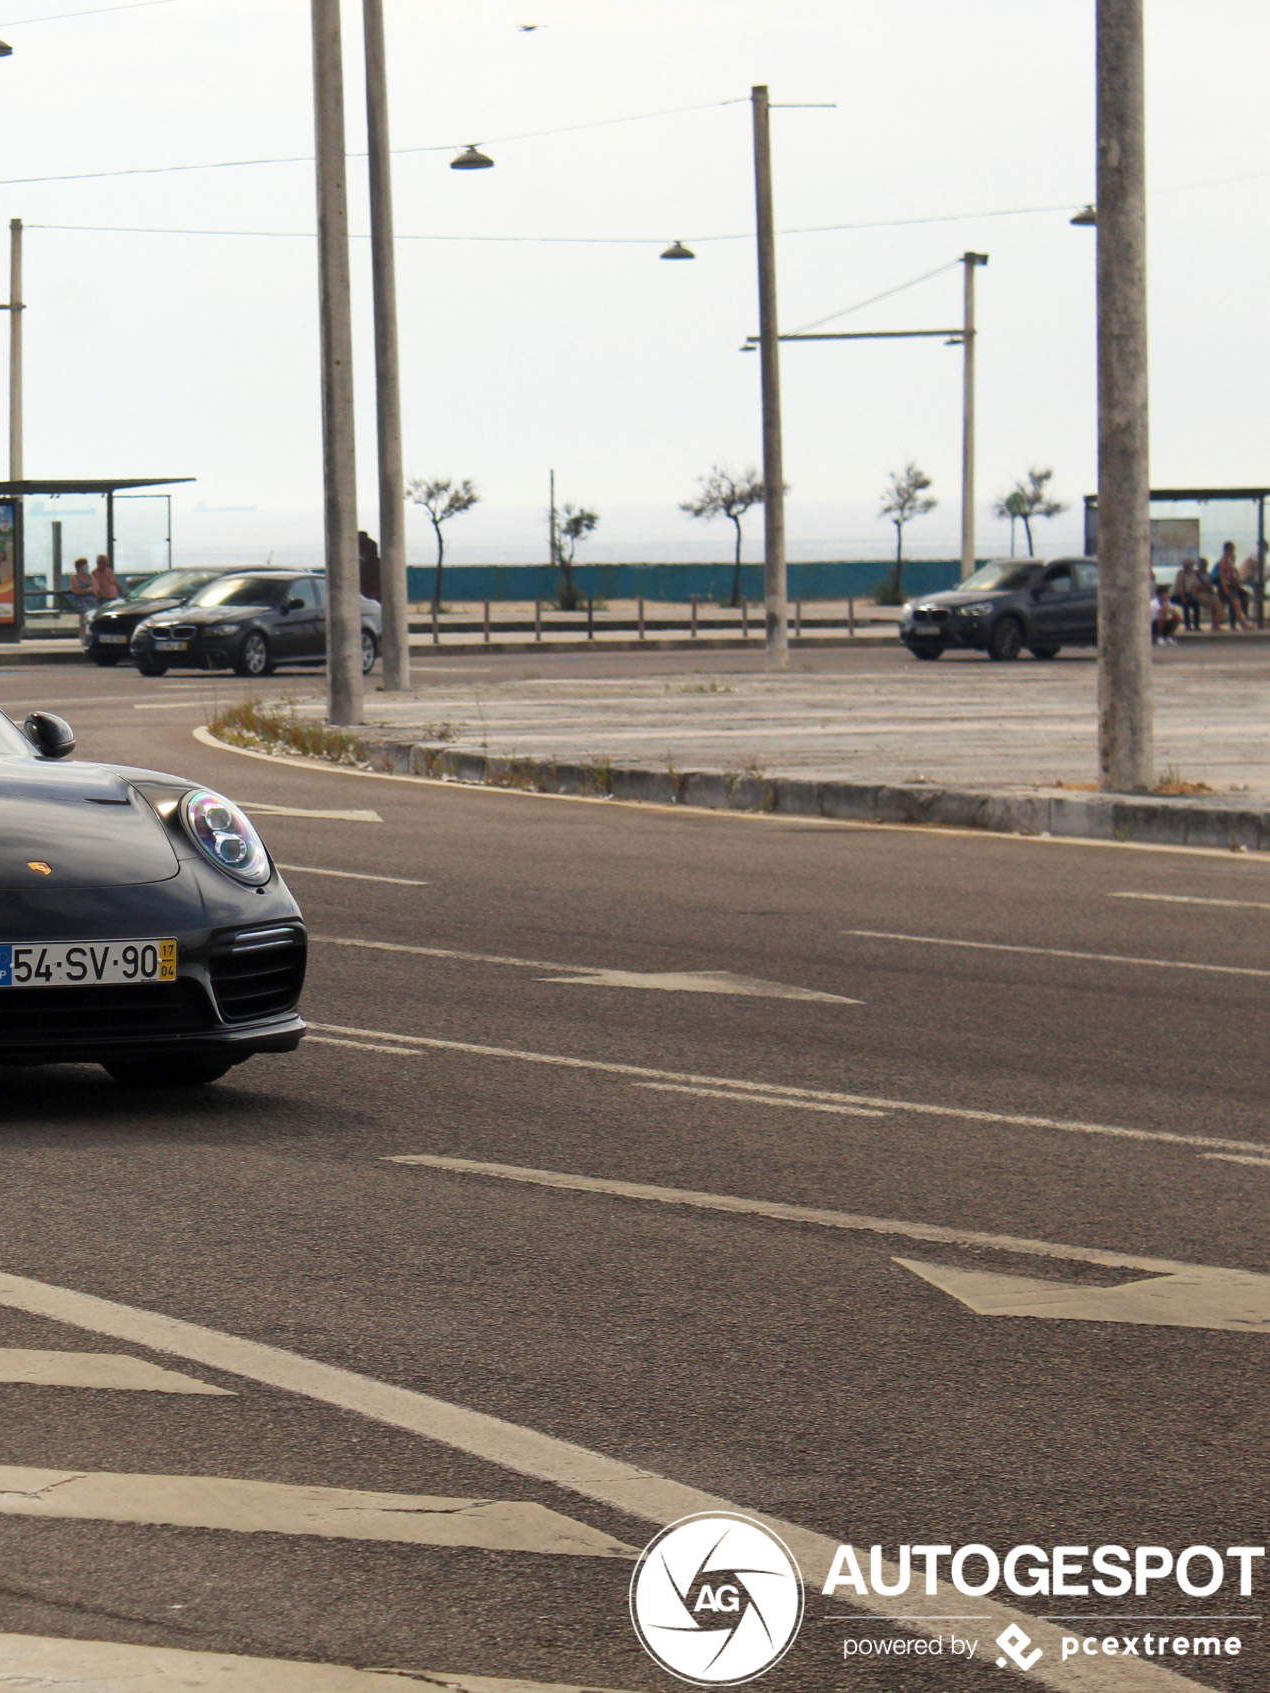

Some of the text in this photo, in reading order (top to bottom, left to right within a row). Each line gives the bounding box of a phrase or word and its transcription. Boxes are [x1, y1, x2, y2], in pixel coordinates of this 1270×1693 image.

[162, 944, 174, 956] 17
[0, 970, 7, 980] P
[161, 965, 174, 976] 04
